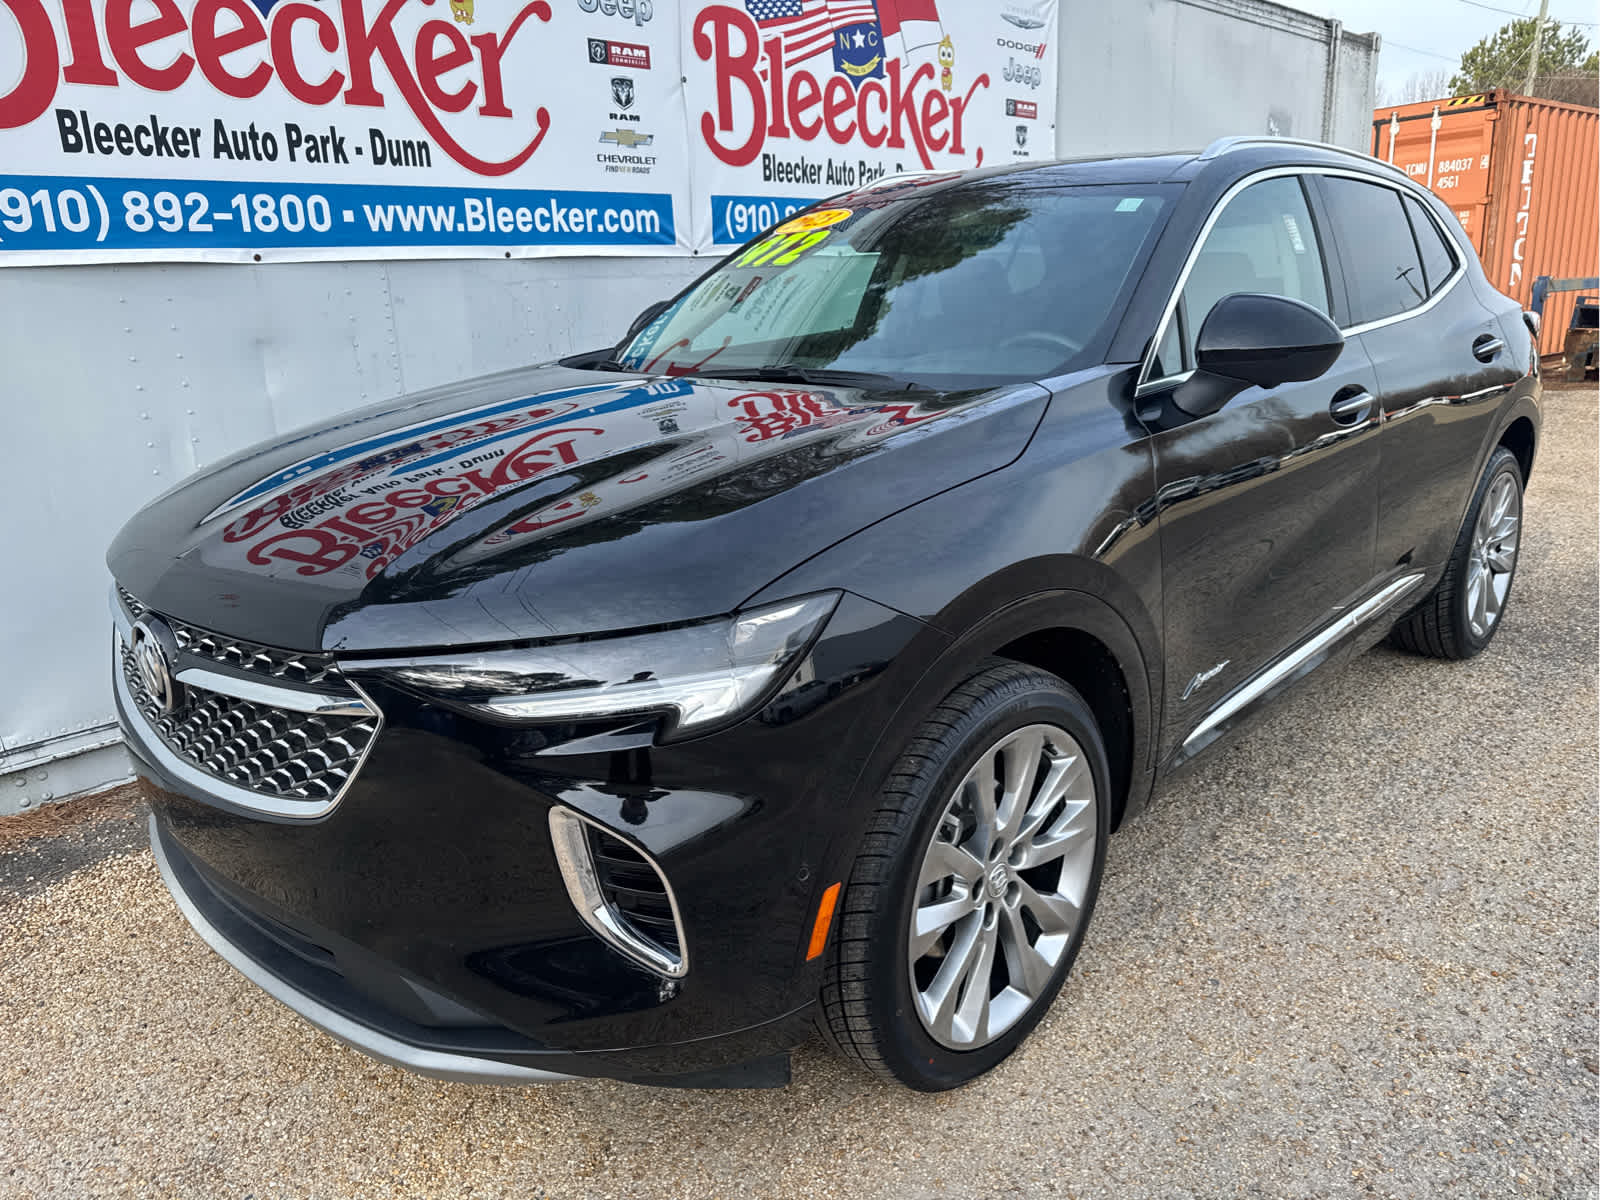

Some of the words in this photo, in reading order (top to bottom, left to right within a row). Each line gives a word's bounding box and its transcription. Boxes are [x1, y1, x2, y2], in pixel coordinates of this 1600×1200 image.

[610, 45, 647, 58] RAM
[996, 38, 1040, 53] DODGE
[693, 5, 990, 169] Bleecker
[1003, 56, 1040, 89] Jeep
[609, 112, 641, 122] RAM
[56, 108, 201, 159] Bleecker
[213, 119, 279, 161] Auto
[286, 123, 348, 165] Park
[370, 127, 431, 168] Dunn
[596, 153, 657, 165] CHEVROLET
[762, 153, 822, 185] Bleecker
[826, 158, 855, 187] Auto
[1438, 157, 1474, 174] 884037
[124, 190, 332, 233] 892-1800
[362, 197, 660, 233] www.Bleecker.com
[725, 200, 780, 239] (910)
